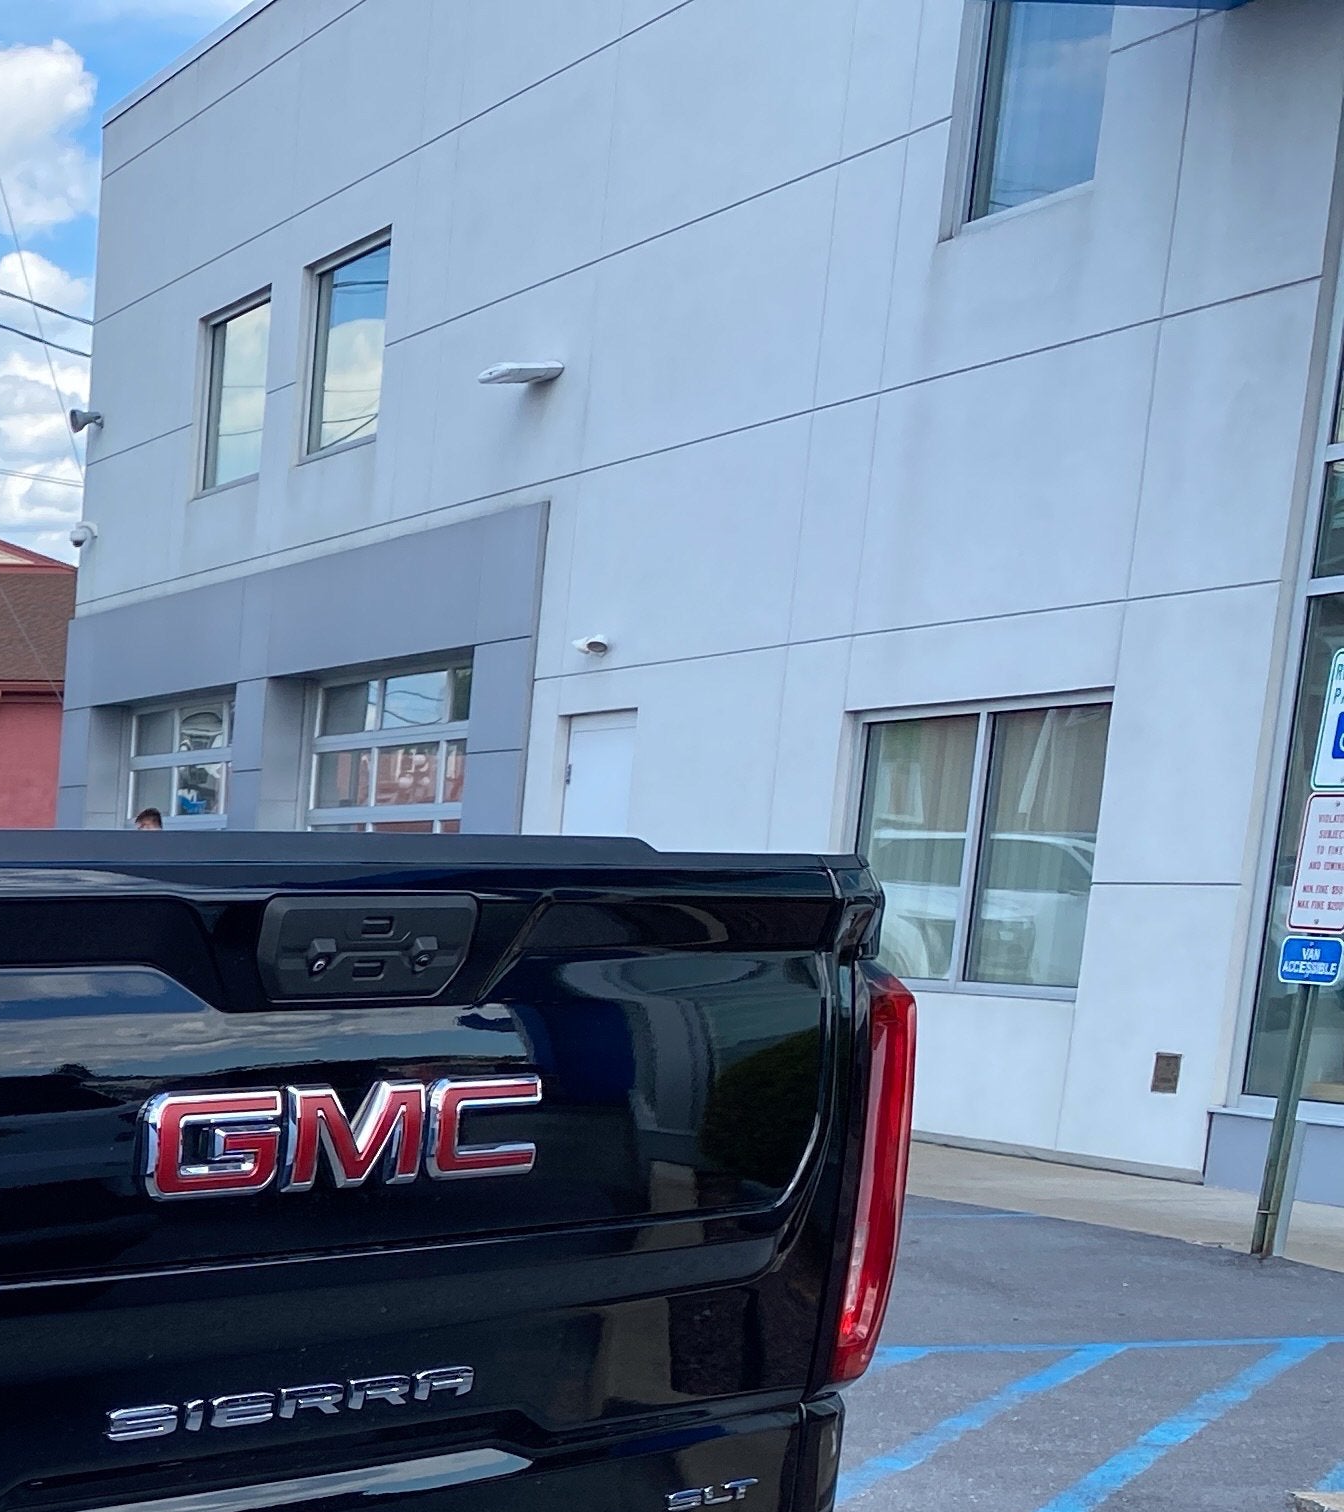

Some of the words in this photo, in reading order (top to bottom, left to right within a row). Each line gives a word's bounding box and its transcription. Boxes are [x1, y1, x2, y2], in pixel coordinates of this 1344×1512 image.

[1282, 961, 1338, 976] ACCESSIBLE
[1302, 948, 1321, 961] VAN
[138, 1074, 542, 1200] GMC
[104, 1366, 474, 1442] SIERRA
[665, 1478, 759, 1511] SLT
